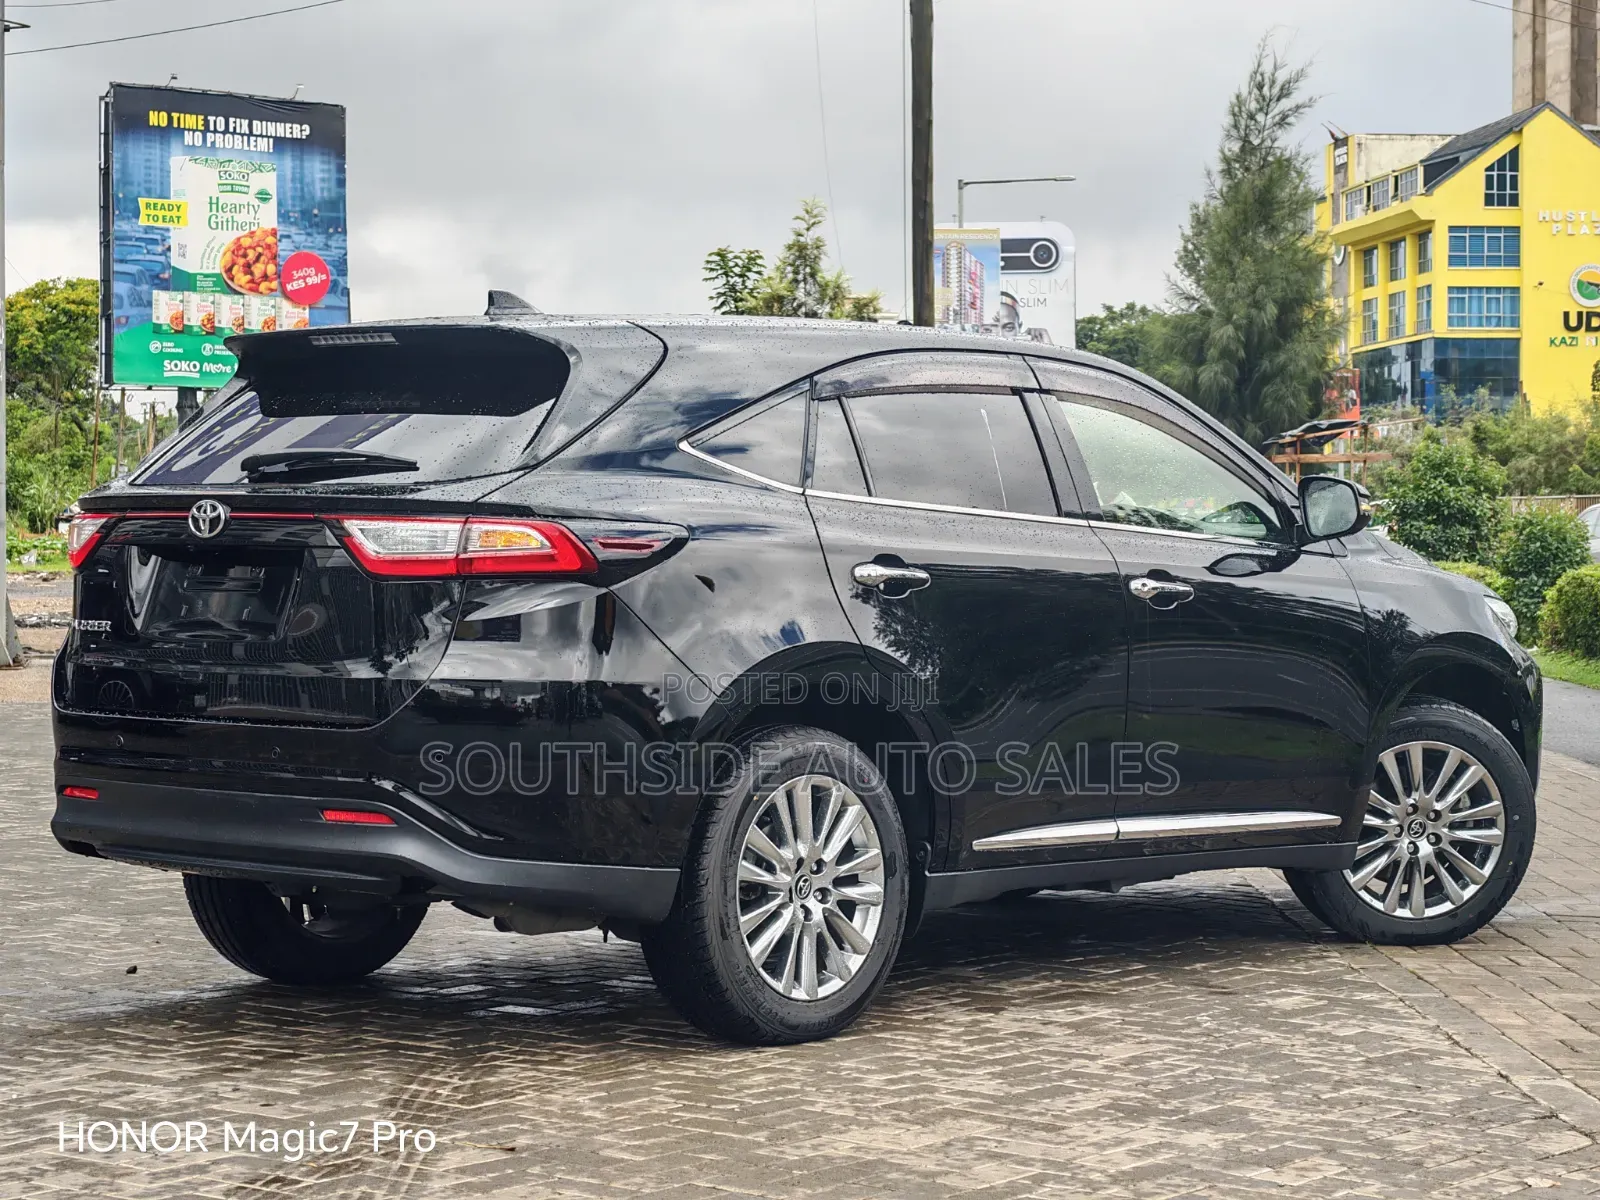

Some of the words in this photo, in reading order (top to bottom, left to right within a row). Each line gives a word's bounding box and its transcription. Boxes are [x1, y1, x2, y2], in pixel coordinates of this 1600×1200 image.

[149, 110, 168, 127] NO
[171, 112, 204, 130] TIME
[207, 116, 225, 132] TO
[229, 117, 249, 134] FIX
[252, 120, 310, 139] DINNER?
[184, 130, 202, 147] NO
[206, 132, 273, 152] PROBLEM!
[219, 171, 249, 181] SOKO
[145, 202, 182, 212] READY
[208, 196, 260, 220] Hearty
[145, 213, 159, 223] TO
[162, 215, 181, 224] EAT
[208, 214, 260, 232] Githeri
[291, 267, 316, 280] 340g
[286, 279, 306, 292] KES
[1028, 278, 1070, 295] SLIM
[1019, 297, 1047, 308] SLIM
[1549, 336, 1579, 347] KAZI
[163, 359, 200, 372] SOKO
